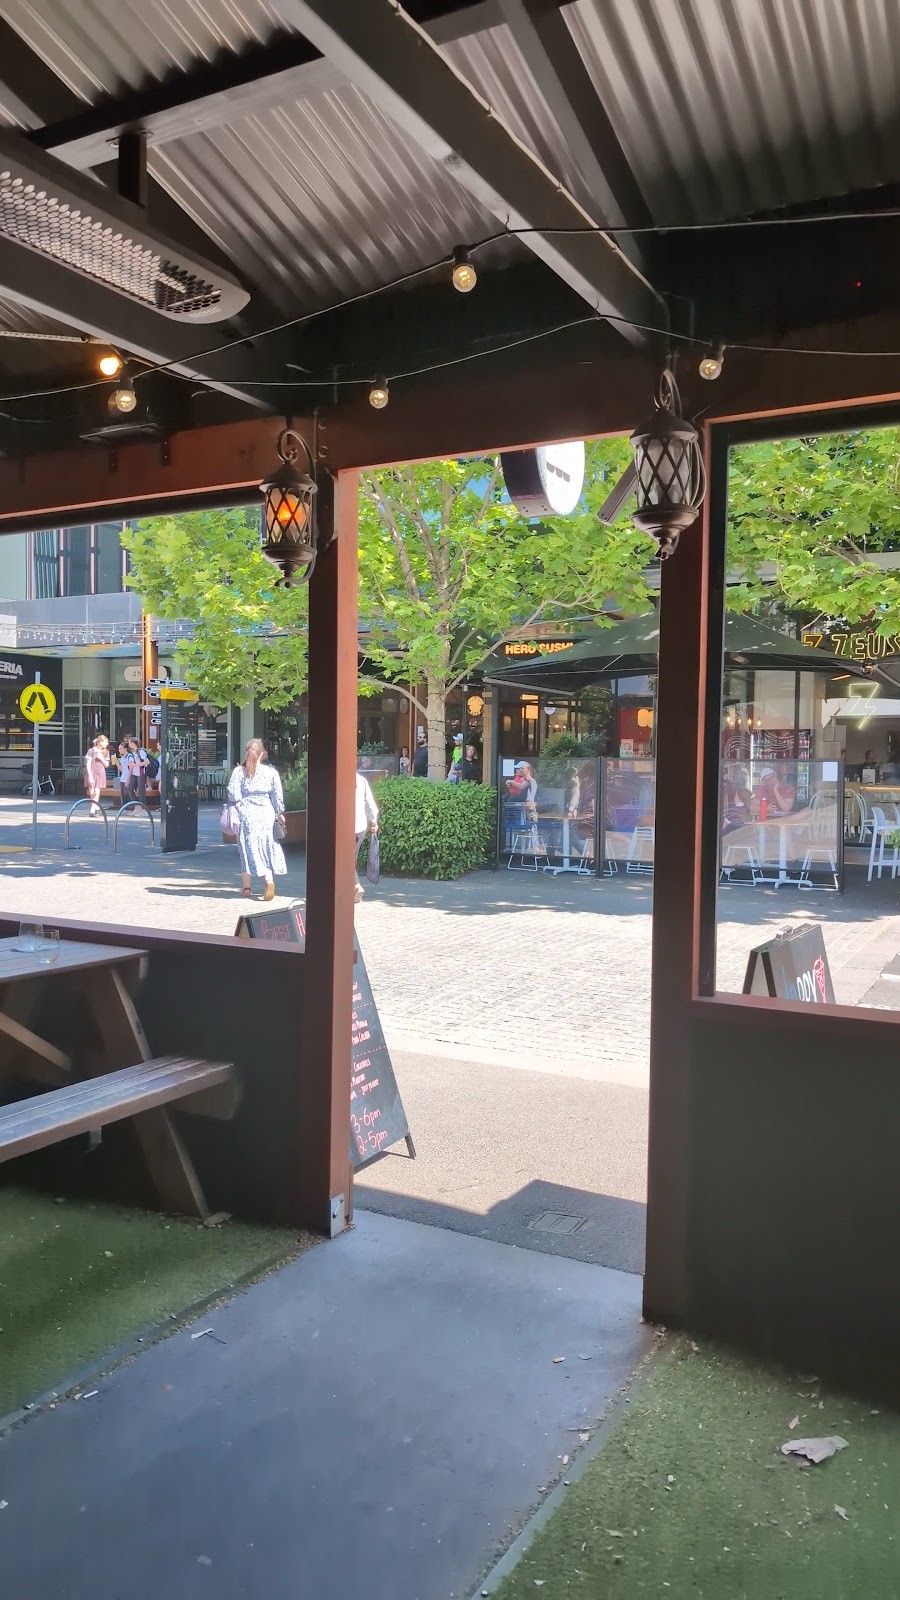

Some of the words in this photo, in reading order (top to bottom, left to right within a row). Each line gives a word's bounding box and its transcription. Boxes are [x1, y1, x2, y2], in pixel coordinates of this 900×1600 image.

[505, 644, 536, 655] HERO
[350, 1107, 381, 1133] 3-6pm
[356, 1130, 388, 1154] 2-5pm
